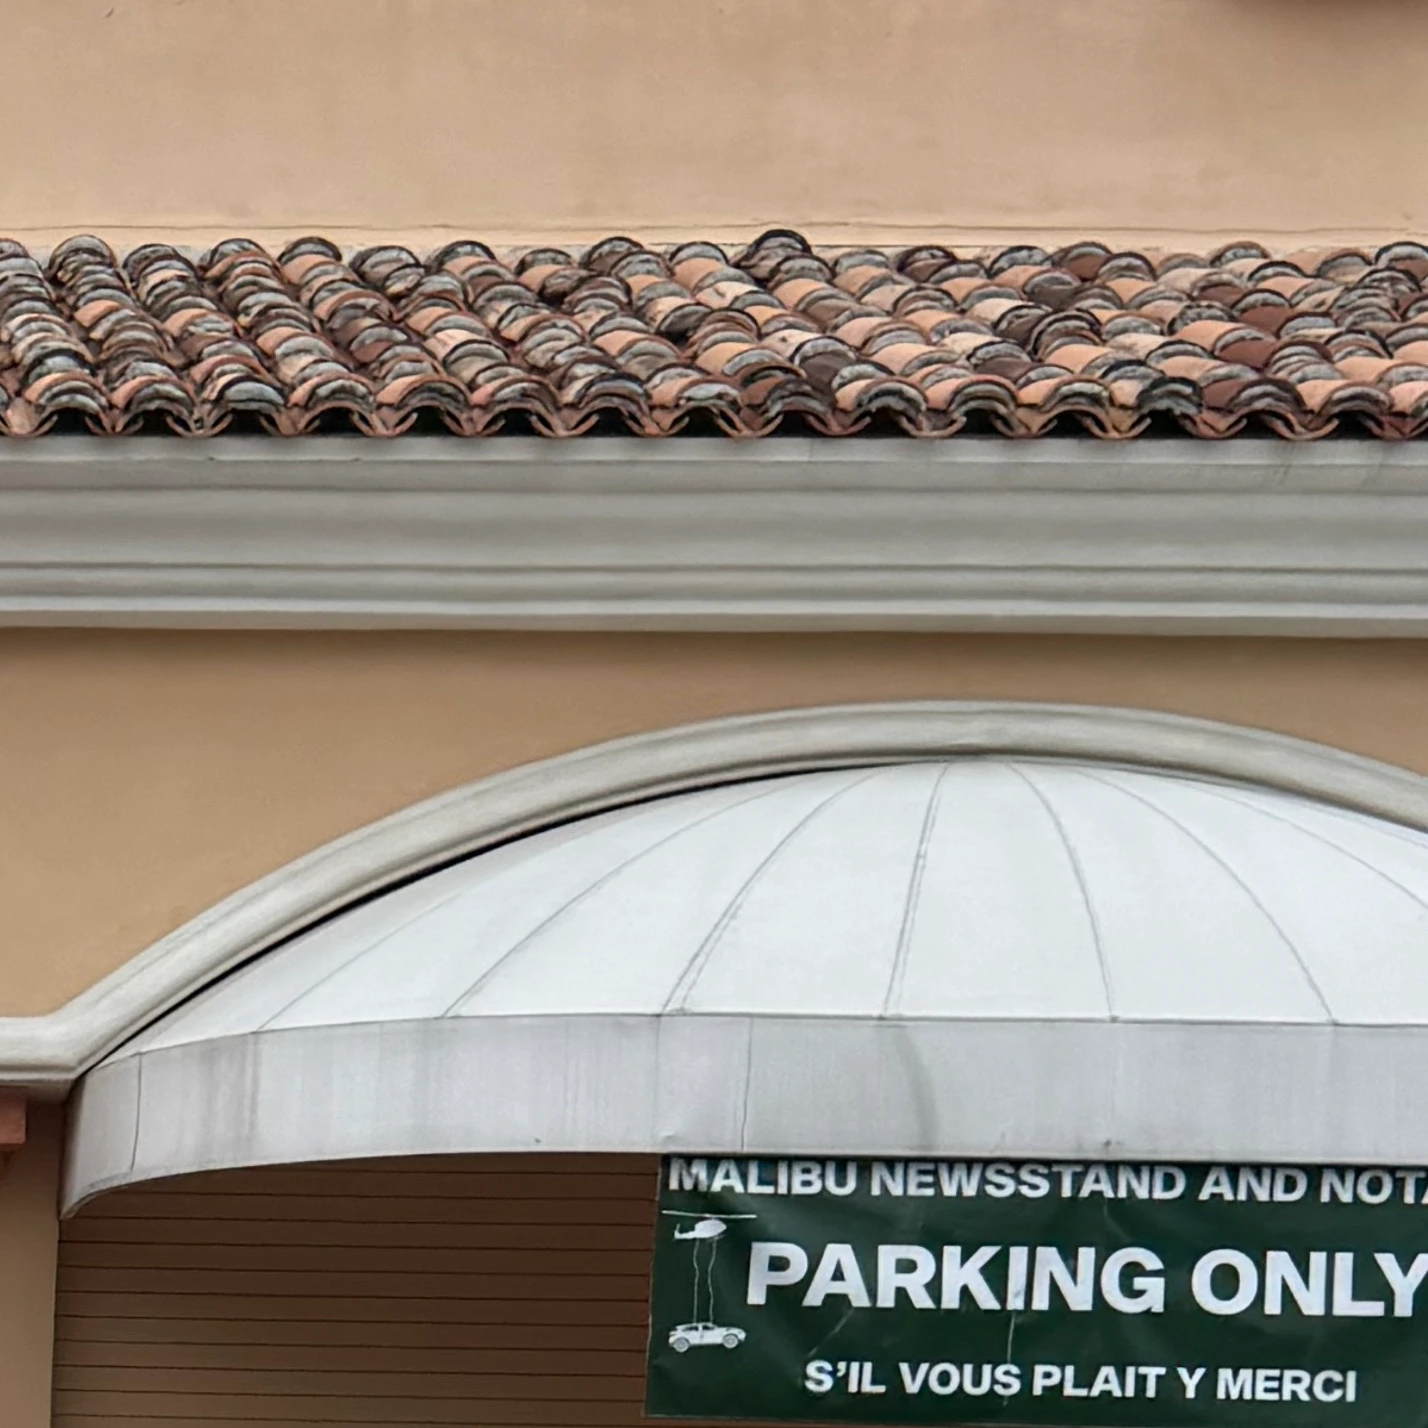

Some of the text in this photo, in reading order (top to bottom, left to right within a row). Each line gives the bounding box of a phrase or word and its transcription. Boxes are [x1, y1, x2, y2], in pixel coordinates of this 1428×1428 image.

[668, 1157, 1428, 1205] MALIBU NEWSSTAND AND NOT
[746, 1241, 1428, 1319] PARKING ONLY
[804, 1361, 1357, 1403] S'IL VOUS PLAIT Y MERCI
